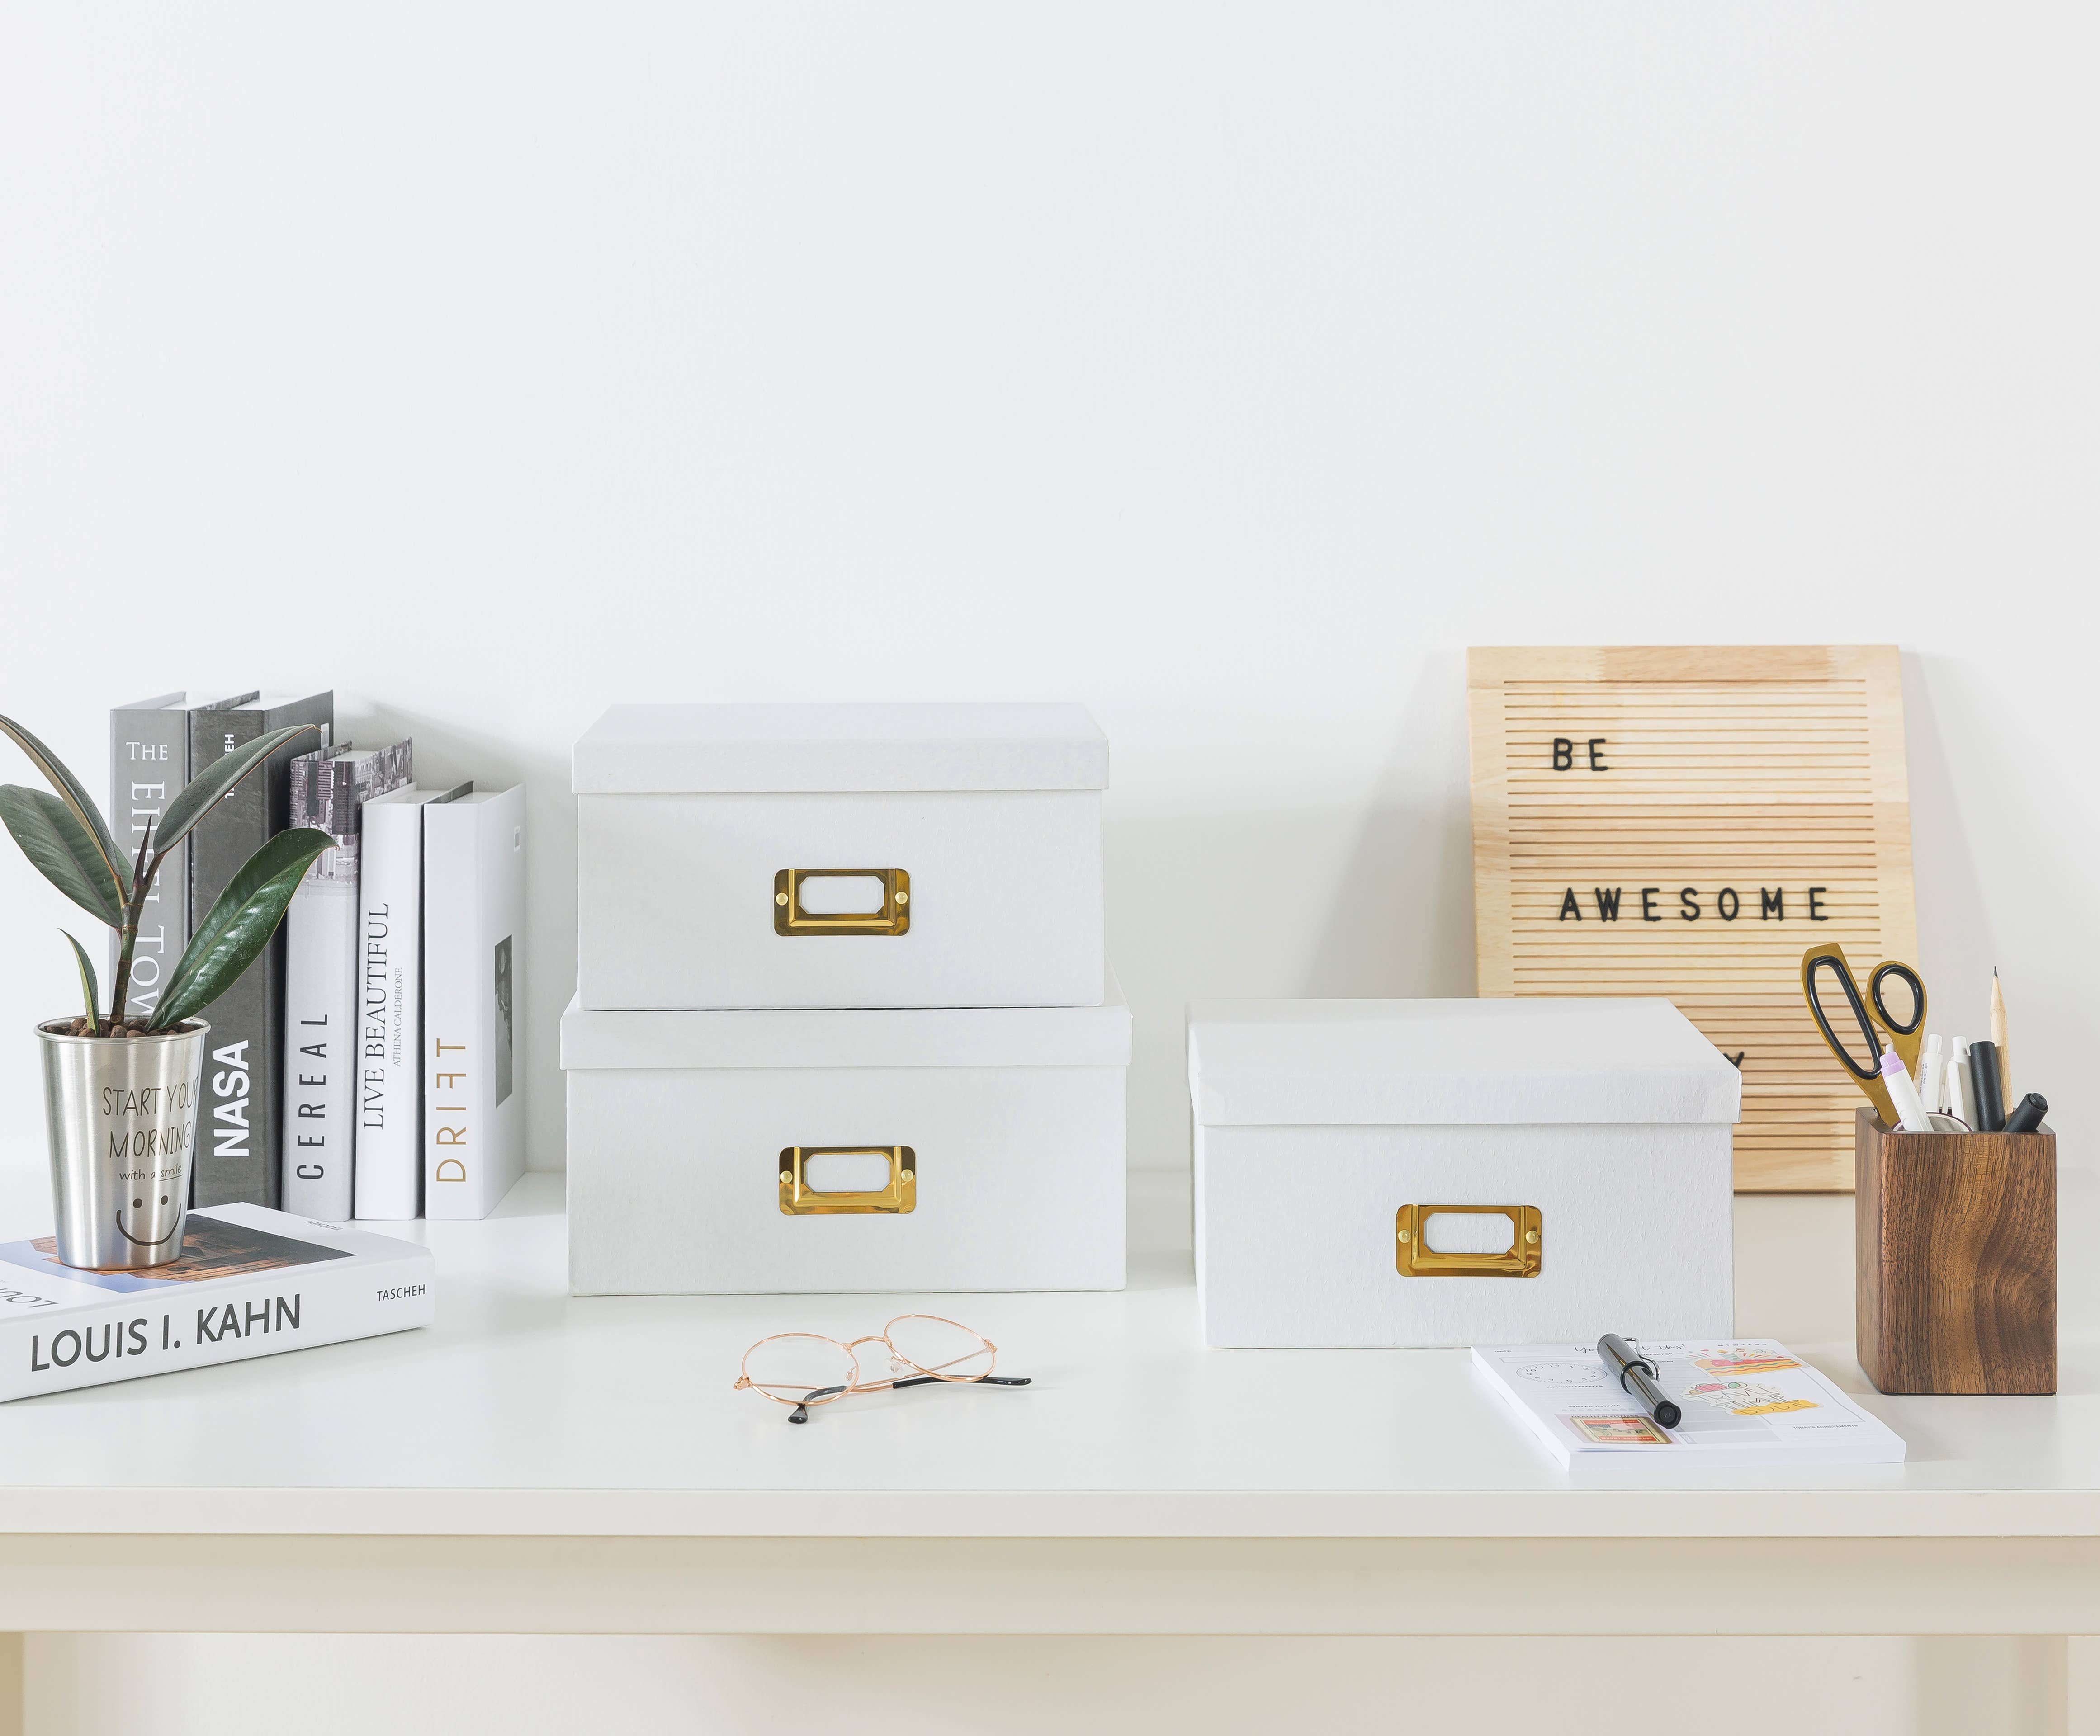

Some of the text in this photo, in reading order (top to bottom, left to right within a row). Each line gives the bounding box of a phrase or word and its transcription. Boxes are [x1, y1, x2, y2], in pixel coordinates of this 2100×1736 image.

[126, 741, 168, 760] THE
[1552, 738, 1608, 771] BE
[1558, 887, 1829, 922] AWESOME
[130, 925, 165, 1014] TOW
[364, 903, 388, 1129] LIVE BEAUTIFUL
[393, 967, 402, 1067] ATHENA CALDERONE
[103, 1087, 161, 1116] START
[213, 1039, 250, 1156] NASA
[296, 1014, 328, 1179] CEREAL
[436, 1038, 466, 1182] DRIFT
[109, 1121, 191, 1158] MORNING
[119, 1169, 145, 1180] with
[161, 1163, 182, 1178] smile
[0, 1288, 59, 1308] LOU
[376, 1284, 425, 1302] TASCHEH
[31, 1293, 300, 1373] LOUIS I. KAHN
